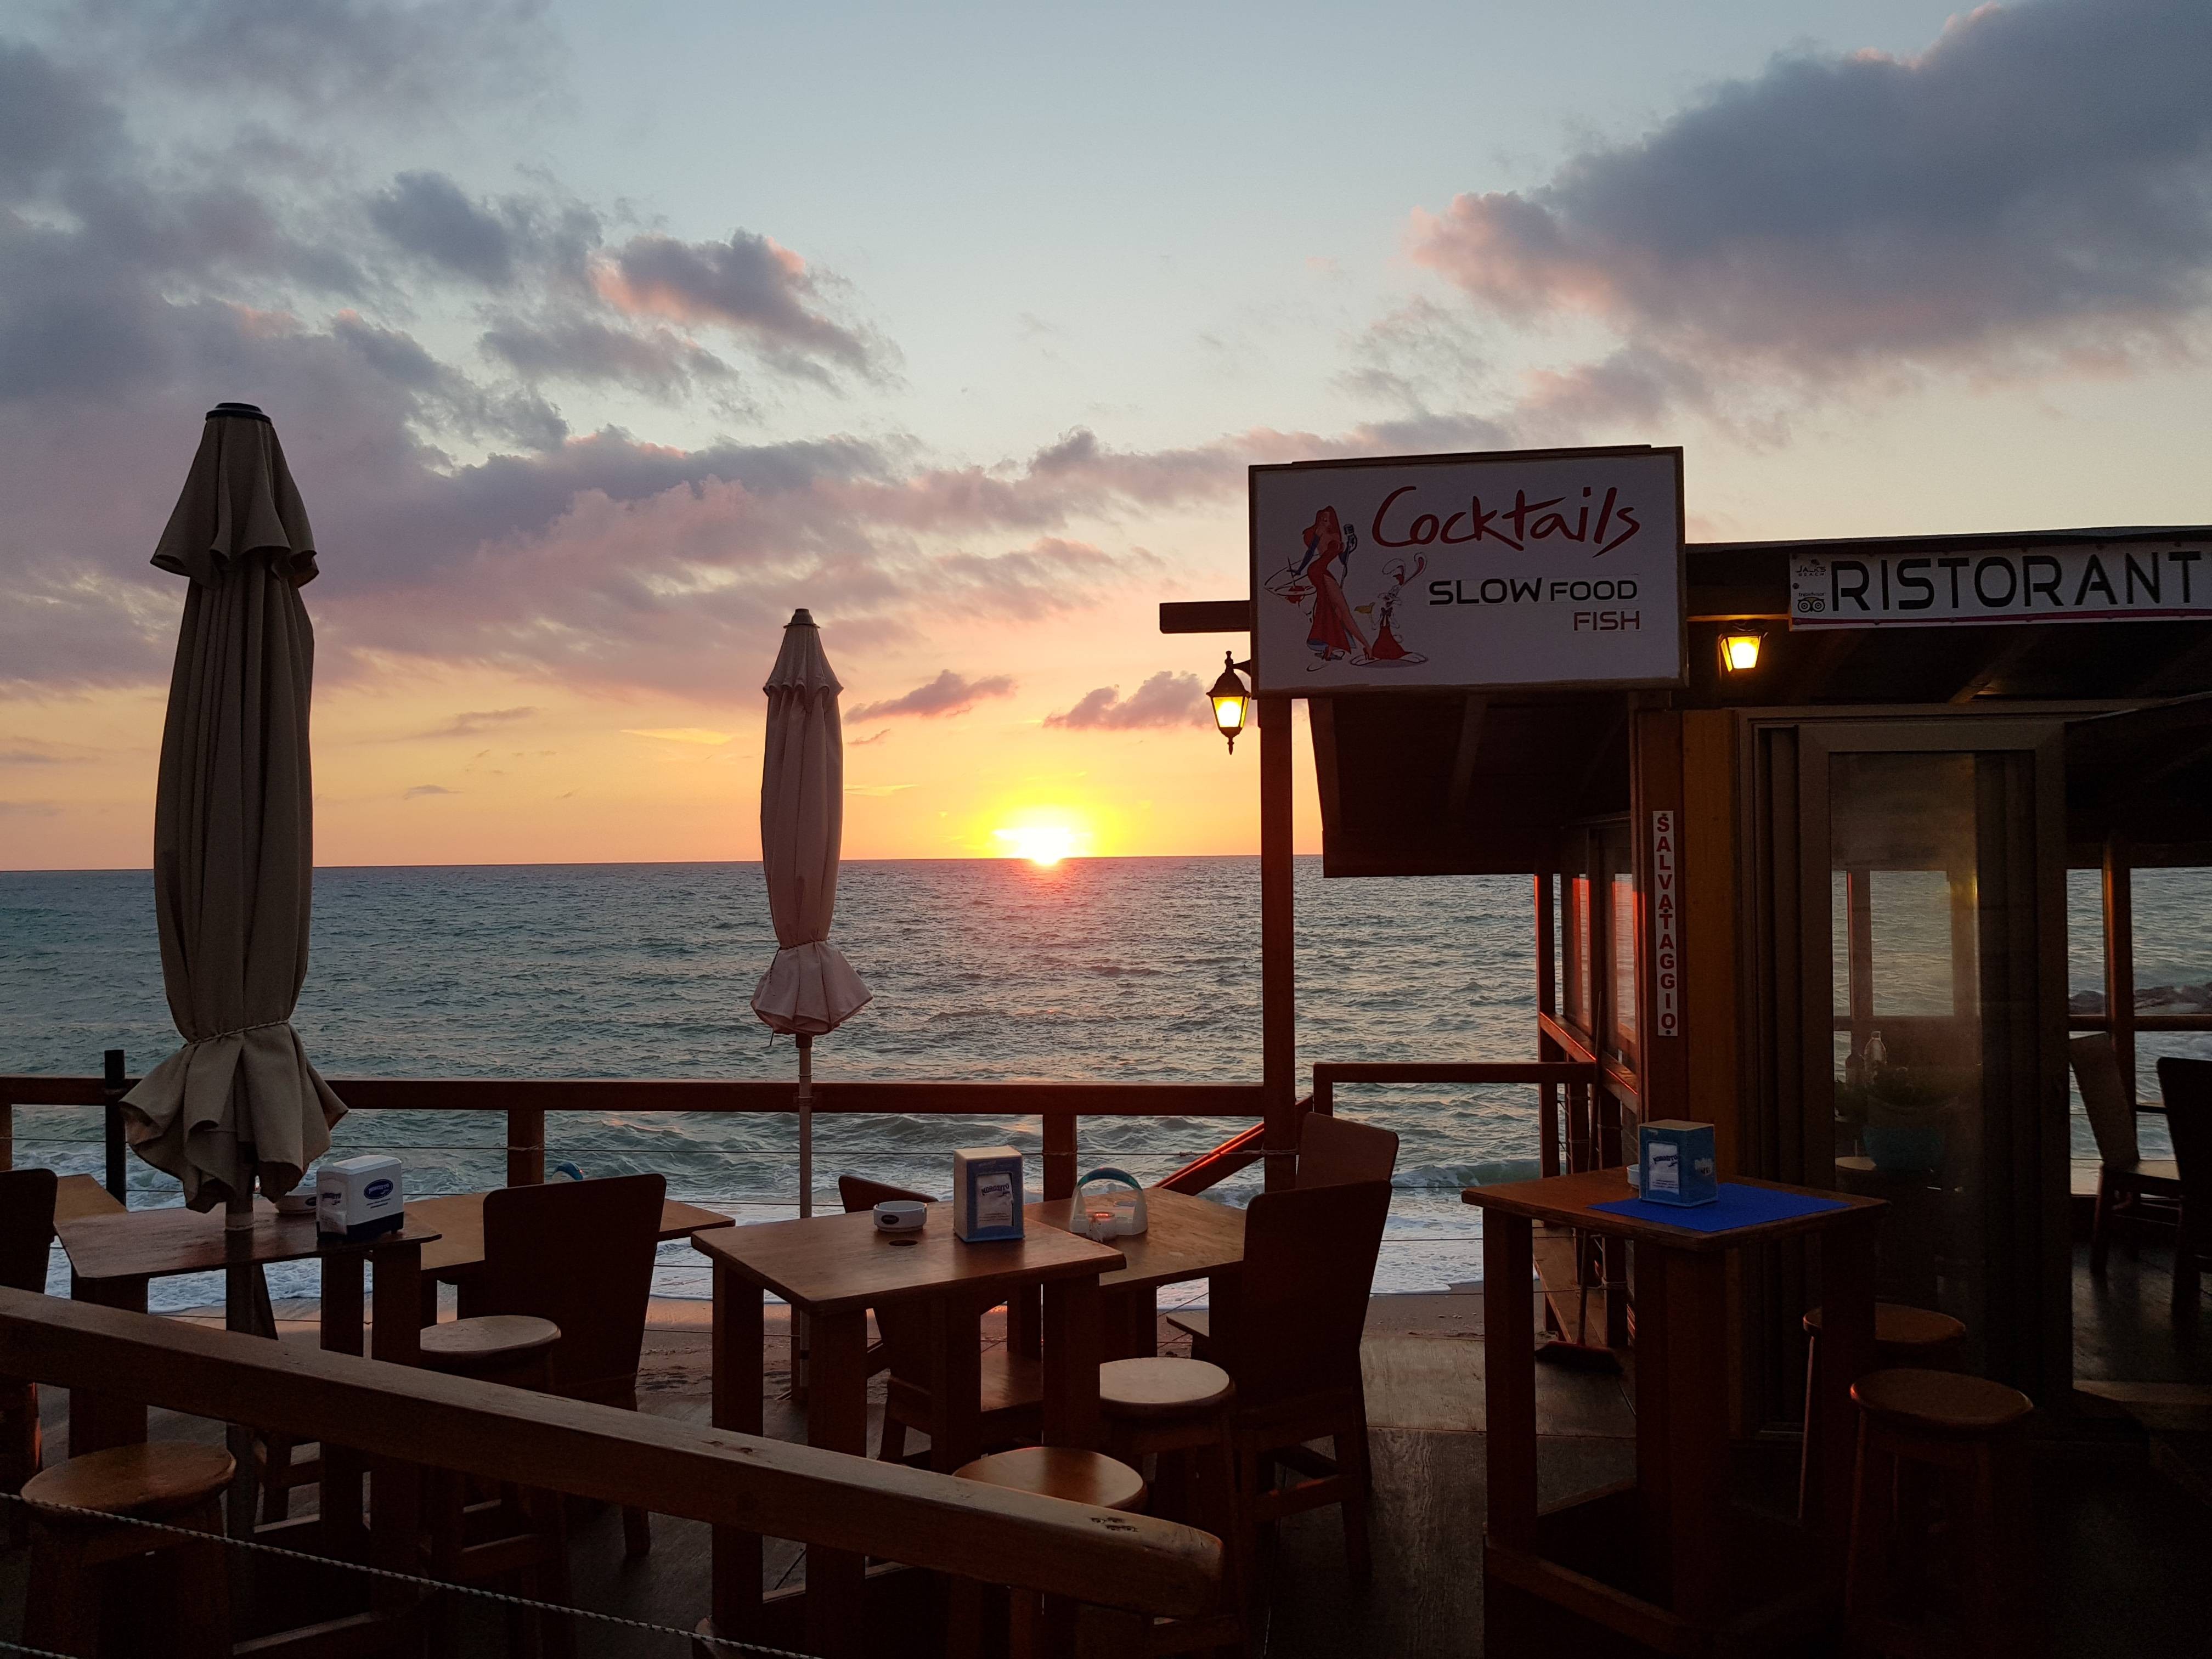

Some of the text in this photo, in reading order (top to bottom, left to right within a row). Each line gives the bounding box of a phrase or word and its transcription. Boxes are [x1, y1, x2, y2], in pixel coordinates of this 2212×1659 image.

[1372, 486, 1641, 558] Cocktails
[1429, 577, 1638, 605] SLOW FOOD
[1831, 550, 2202, 612] RISTORANT
[1573, 610, 1640, 631] FISH
[1656, 816, 1677, 1030] SALVATAGGIO
